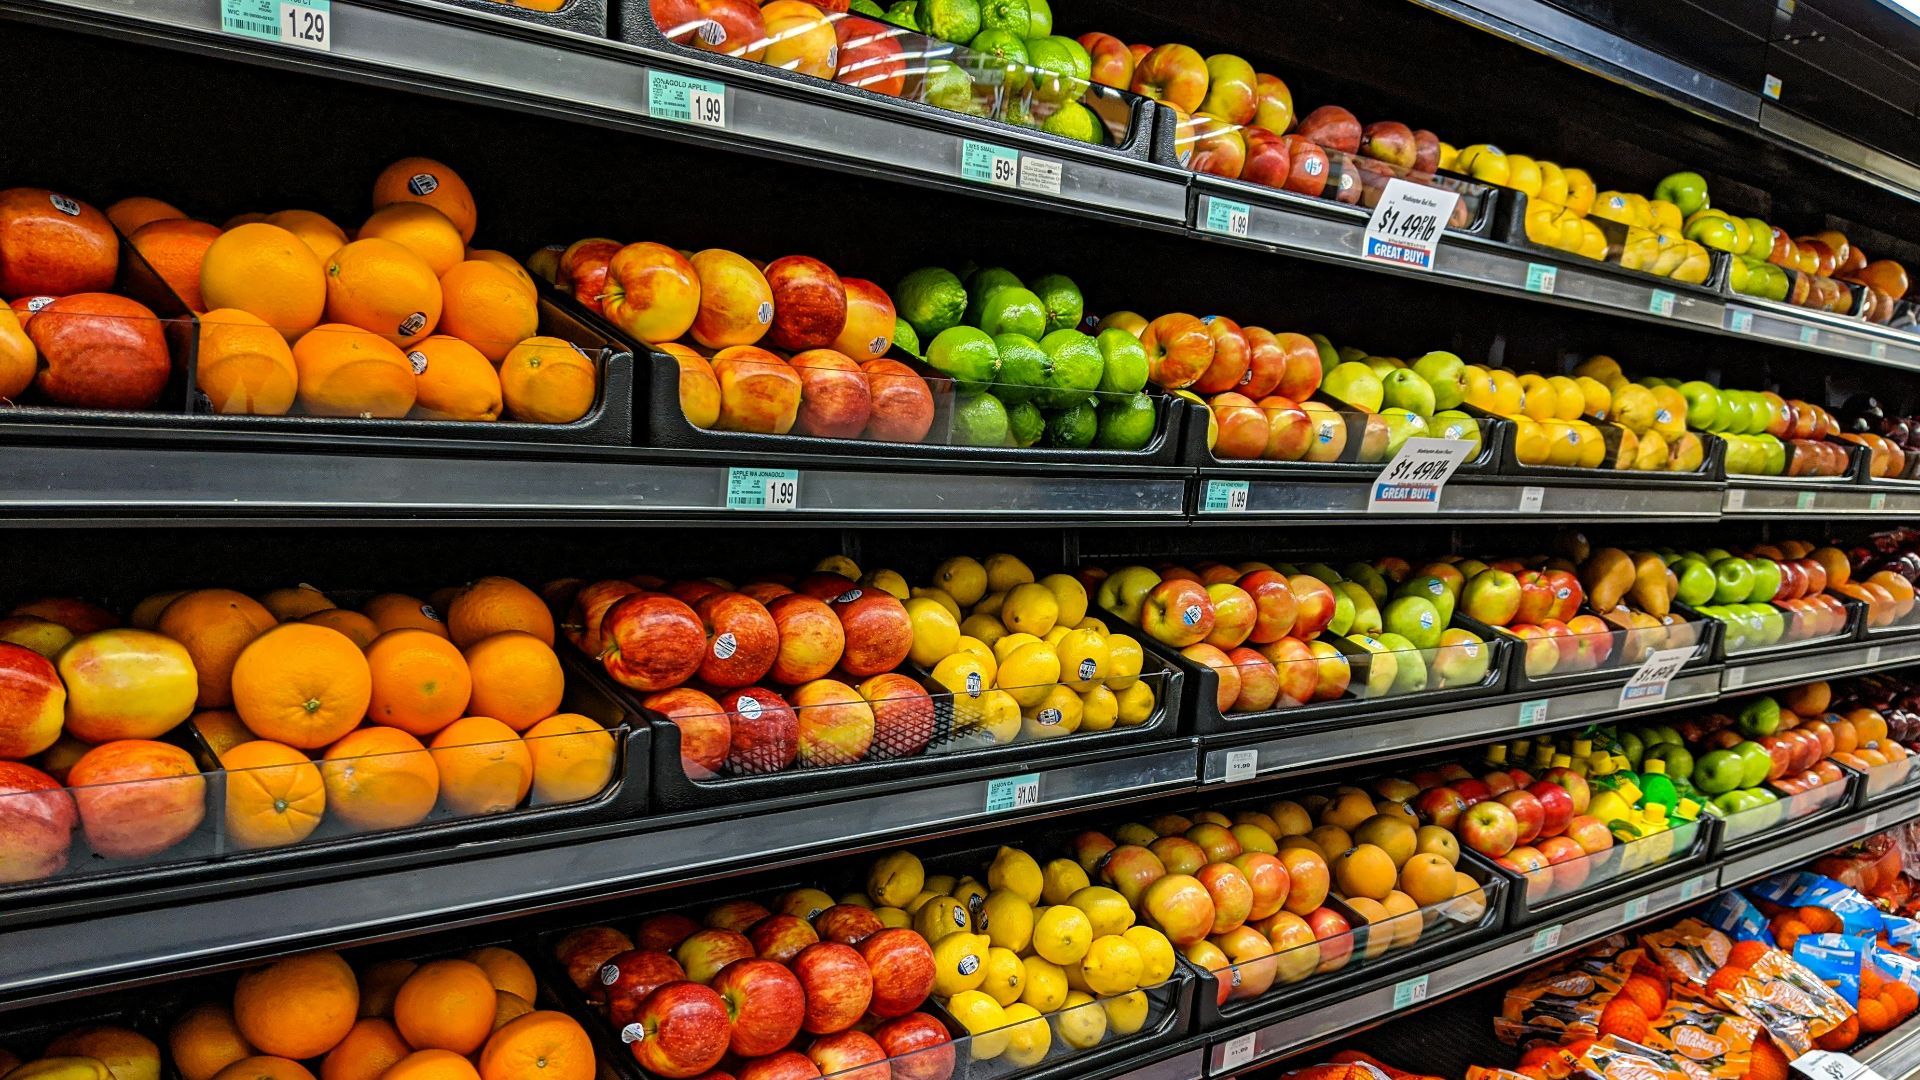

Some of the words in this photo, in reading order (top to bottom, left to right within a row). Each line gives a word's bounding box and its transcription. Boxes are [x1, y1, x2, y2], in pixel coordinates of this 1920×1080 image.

[289, 9, 325, 42] 1.29
[653, 77, 687, 88] JONAGOLD
[688, 83, 708, 92] APPLE
[696, 96, 721, 122] 1.99
[1232, 214, 1247, 234] 1.99
[1378, 205, 1421, 239] $1.49
[1374, 243, 1402, 260] GREAT
[1403, 249, 1425, 265] BUY!
[1389, 458, 1434, 480] $1.49
[771, 481, 794, 504] 1.99
[1231, 490, 1246, 508] 1.99
[1381, 487, 1411, 499] GREAT
[1411, 487, 1431, 499] BUY!
